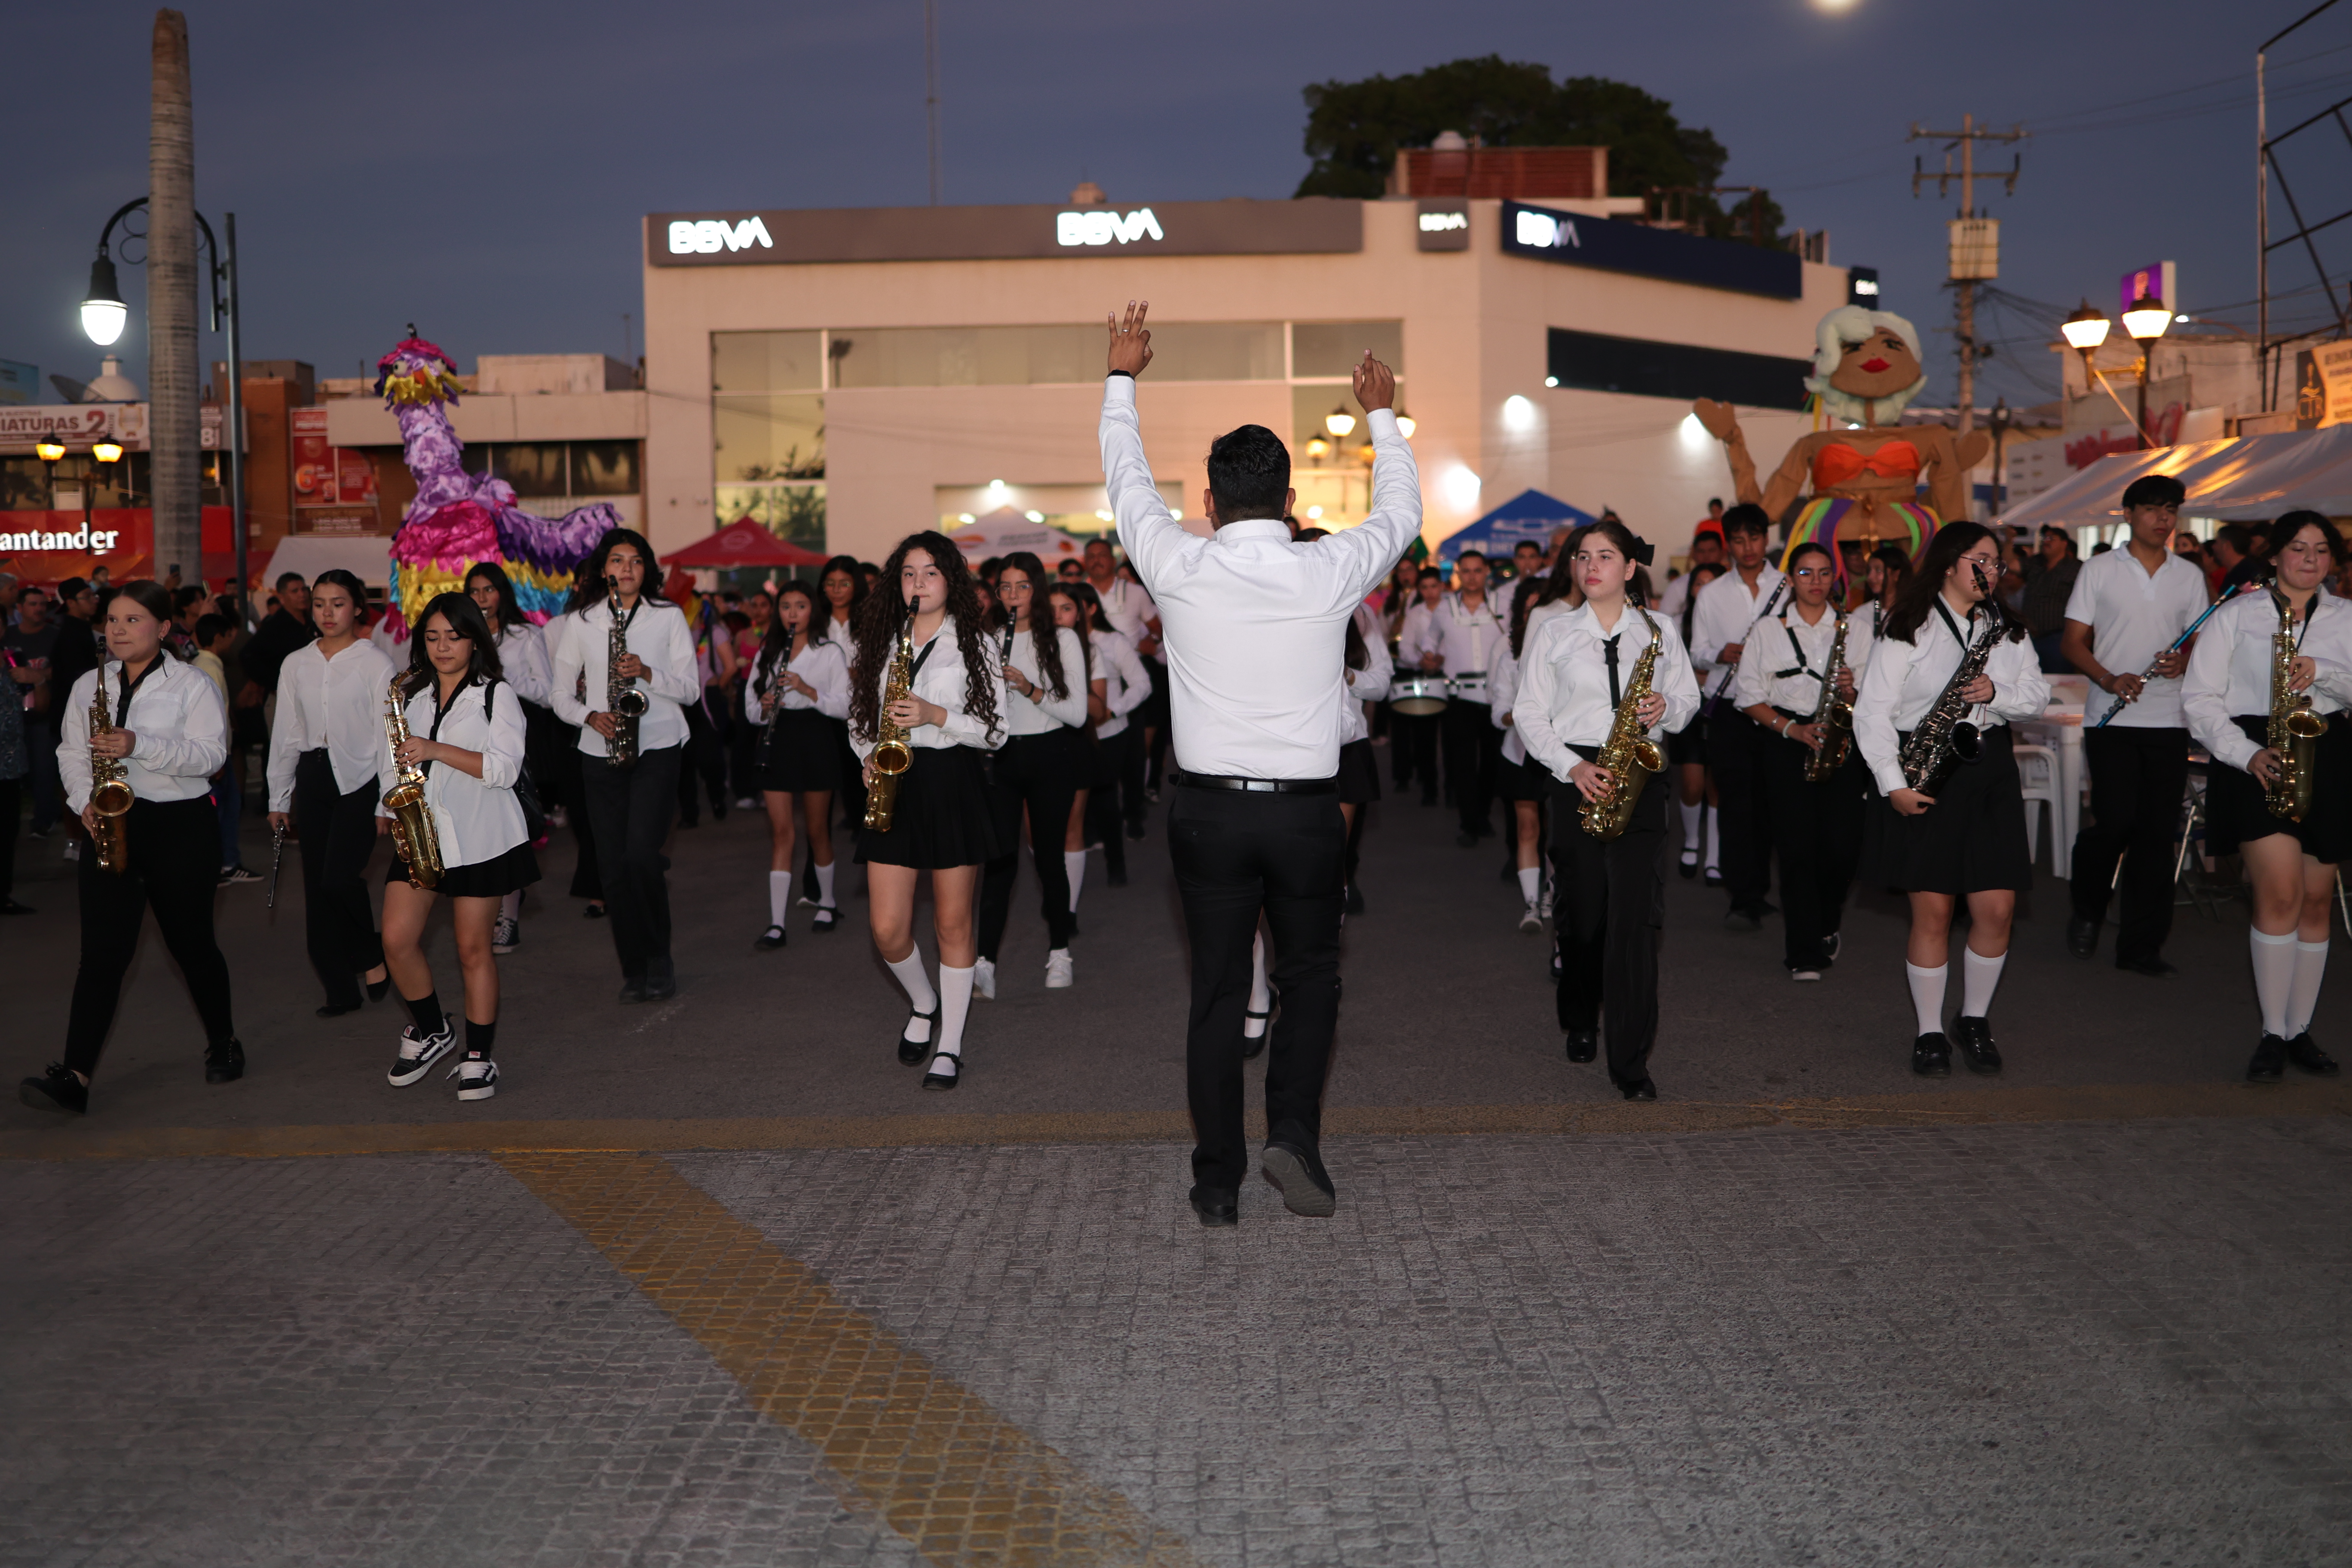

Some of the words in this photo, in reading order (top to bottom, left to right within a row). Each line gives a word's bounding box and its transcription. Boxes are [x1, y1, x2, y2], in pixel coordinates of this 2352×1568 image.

[669, 216, 773, 254] BBVA
[1057, 208, 1164, 245] BBVA
[1419, 212, 1468, 231] BBVA
[1517, 210, 1580, 248] BBVA
[2, 416, 79, 431] IATURAS
[87, 410, 105, 432] 2
[0, 521, 119, 555] antander
